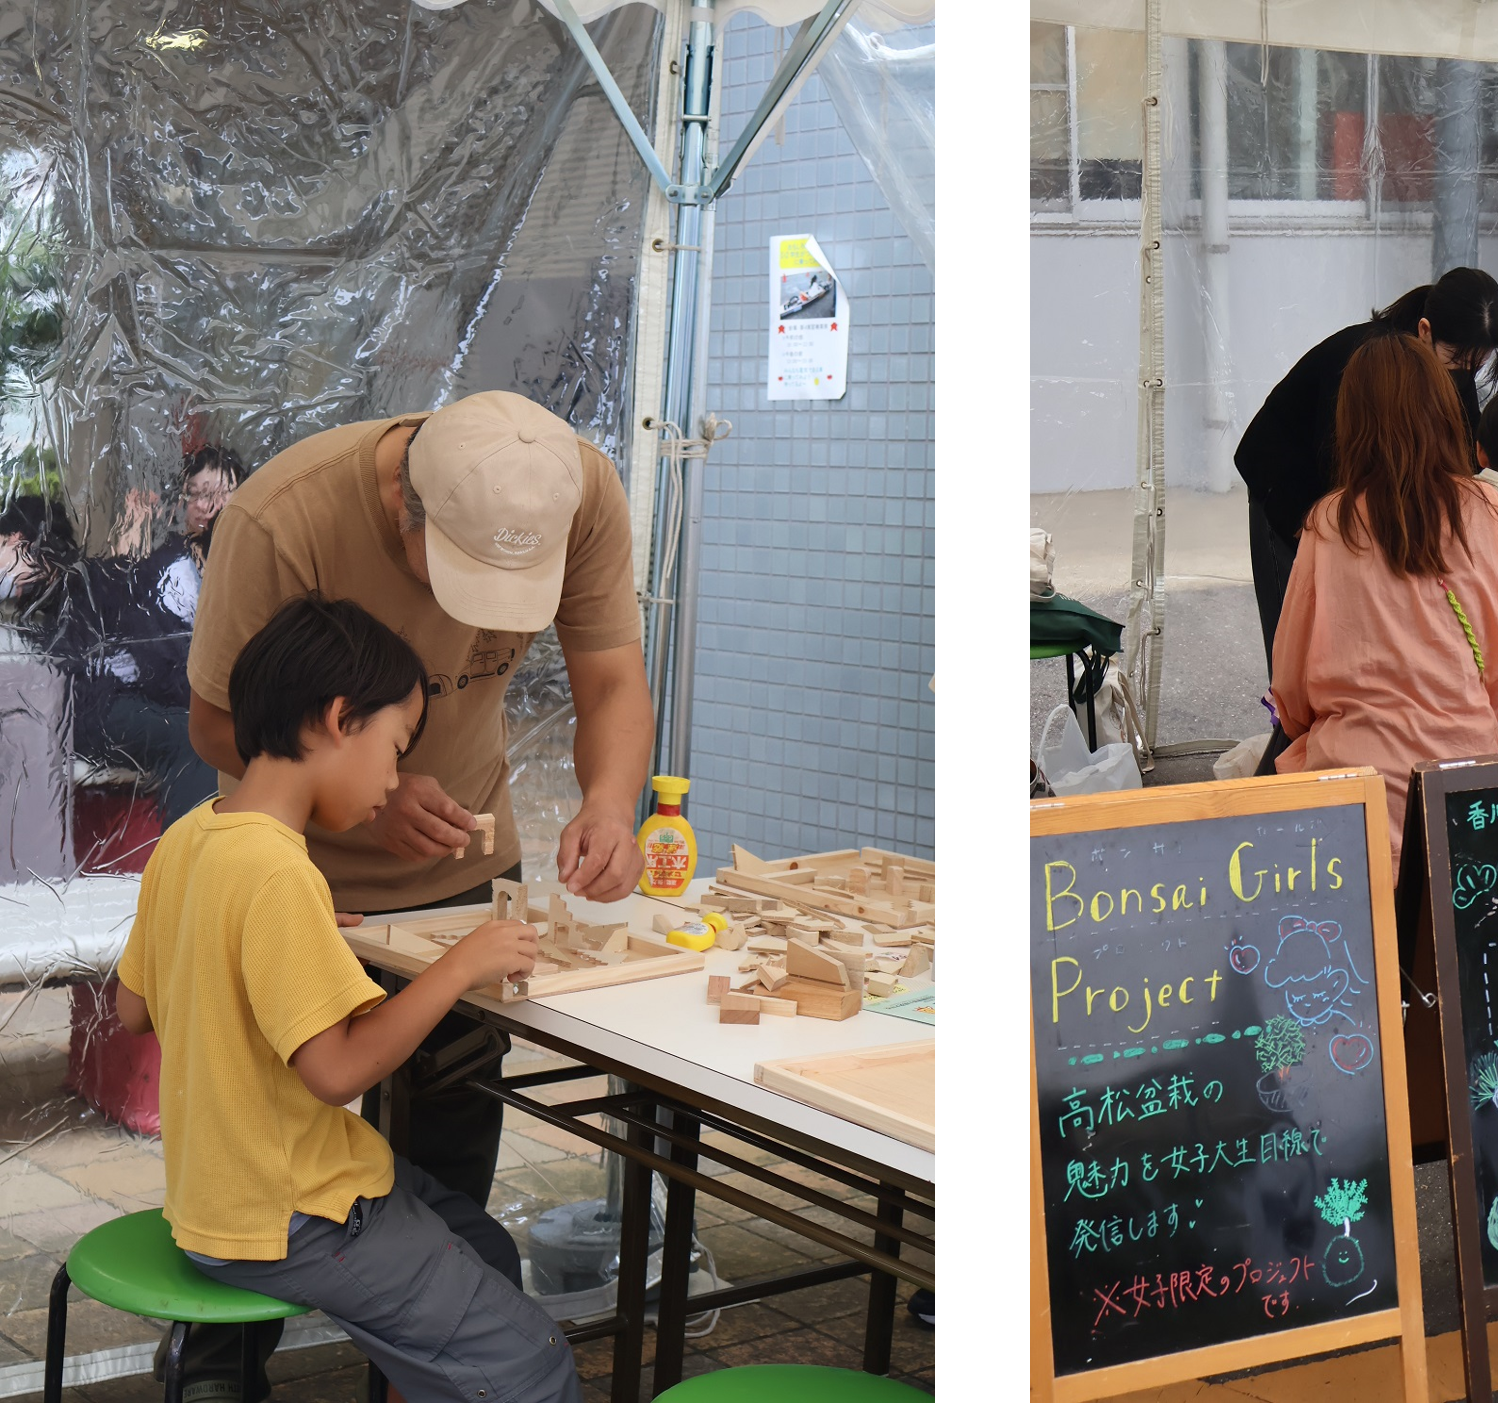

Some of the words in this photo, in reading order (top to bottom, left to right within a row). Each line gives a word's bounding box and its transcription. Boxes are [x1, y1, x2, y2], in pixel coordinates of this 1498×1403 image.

[493, 527, 542, 546] Dickies
[646, 854, 687, 869] 木工用
[1045, 860, 1207, 932] Bonsai
[1228, 838, 1344, 902] Girls
[1051, 956, 1223, 1033] Project
[1058, 1072, 1224, 1138] 高松盆栽の
[1064, 1128, 1327, 1202] 魅力を女子大生目線で
[183, 1382, 226, 1398] HARDWARE
